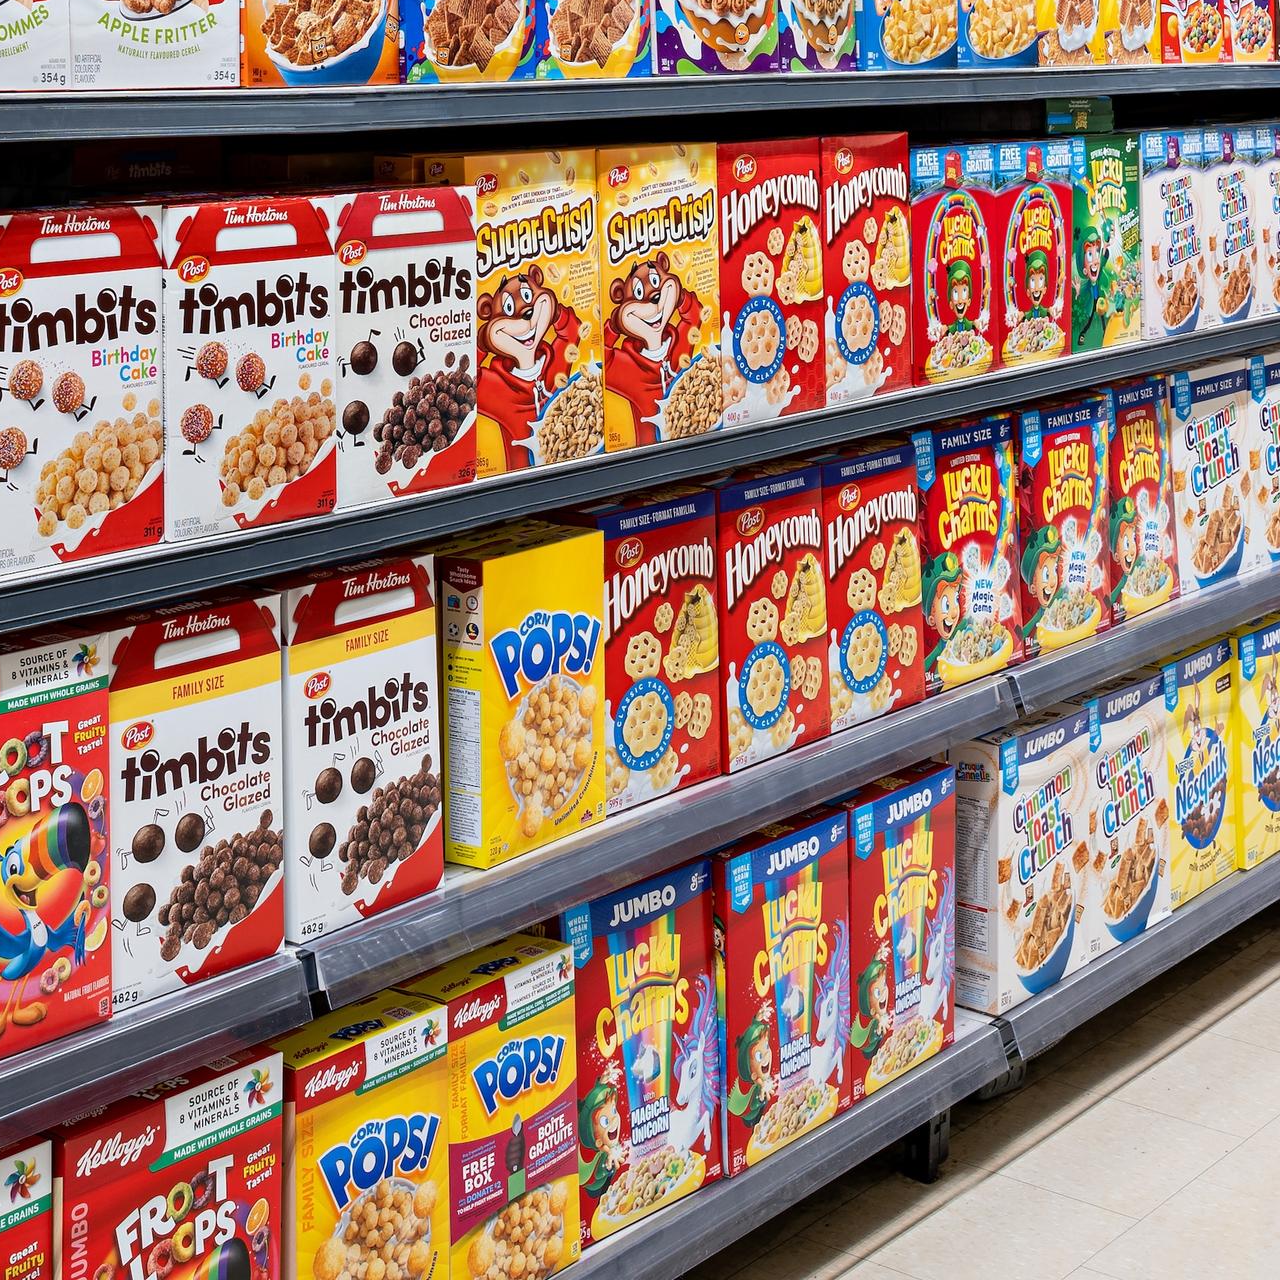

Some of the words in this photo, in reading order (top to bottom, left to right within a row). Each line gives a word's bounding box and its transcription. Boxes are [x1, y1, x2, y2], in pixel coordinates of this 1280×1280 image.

[98, 13, 151, 43] APPLE
[154, 13, 218, 46] FRITTER
[41, 73, 58, 84] 354
[60, 76, 66, 86] g
[966, 158, 993, 172] GRATUIT
[721, 173, 818, 255] Honeycomb
[1020, 206, 1050, 228] Lucky
[1020, 223, 1052, 254] Charms
[409, 310, 471, 329] Chocolate
[735, 299, 759, 337] CLASSIC
[762, 298, 782, 323] TASTE
[430, 324, 471, 343] Glazed
[91, 345, 157, 368] Birthday
[119, 363, 157, 382] Cake
[1185, 402, 1237, 447] Cinnamon
[1196, 431, 1231, 461] Toast
[1191, 447, 1240, 496] Crunch
[971, 590, 994, 606] Magic
[975, 579, 993, 591] NEW
[973, 601, 992, 615] Gems
[520, 611, 551, 636] CORN
[491, 614, 601, 698] POPS!
[172, 679, 203, 699] FAMILY
[205, 674, 225, 691] SIZE
[1176, 739, 1227, 814] Nesquik
[610, 885, 676, 926] JUMBO
[300, 923, 315, 935] 482
[317, 923, 323, 933] g
[604, 934, 681, 1007] Lucky
[596, 979, 689, 1058] Charms
[631, 1094, 669, 1126] MAGICAL
[631, 1112, 669, 1146] UNICORN
